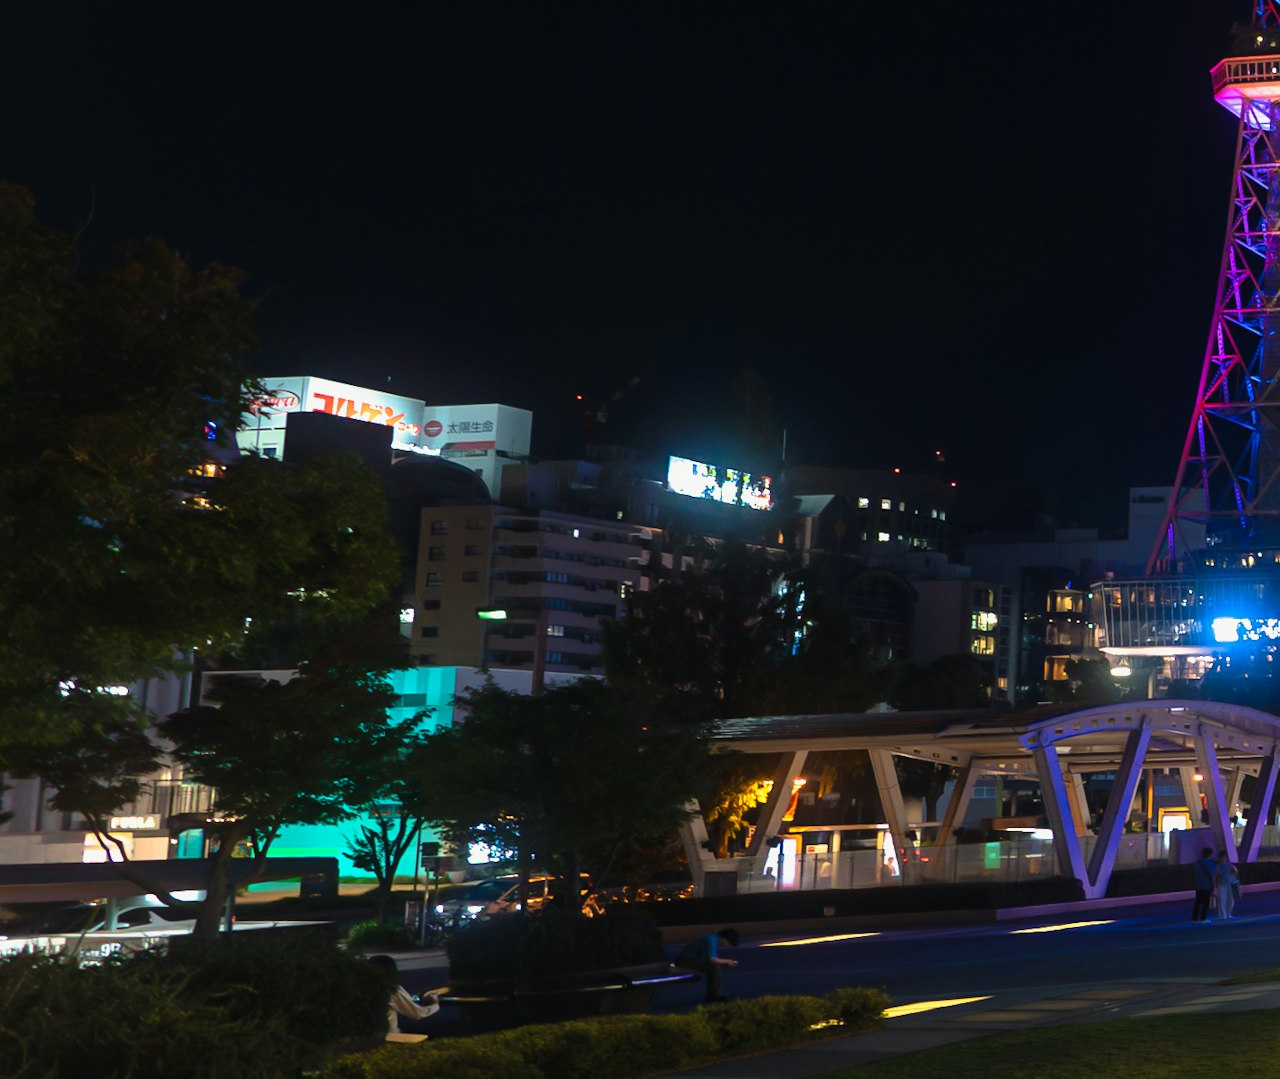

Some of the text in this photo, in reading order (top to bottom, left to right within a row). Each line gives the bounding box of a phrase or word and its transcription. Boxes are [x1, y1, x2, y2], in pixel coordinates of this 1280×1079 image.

[313, 392, 406, 427] コルゲン
[446, 420, 494, 434] 太陽生命
[111, 816, 156, 829] FURLA
